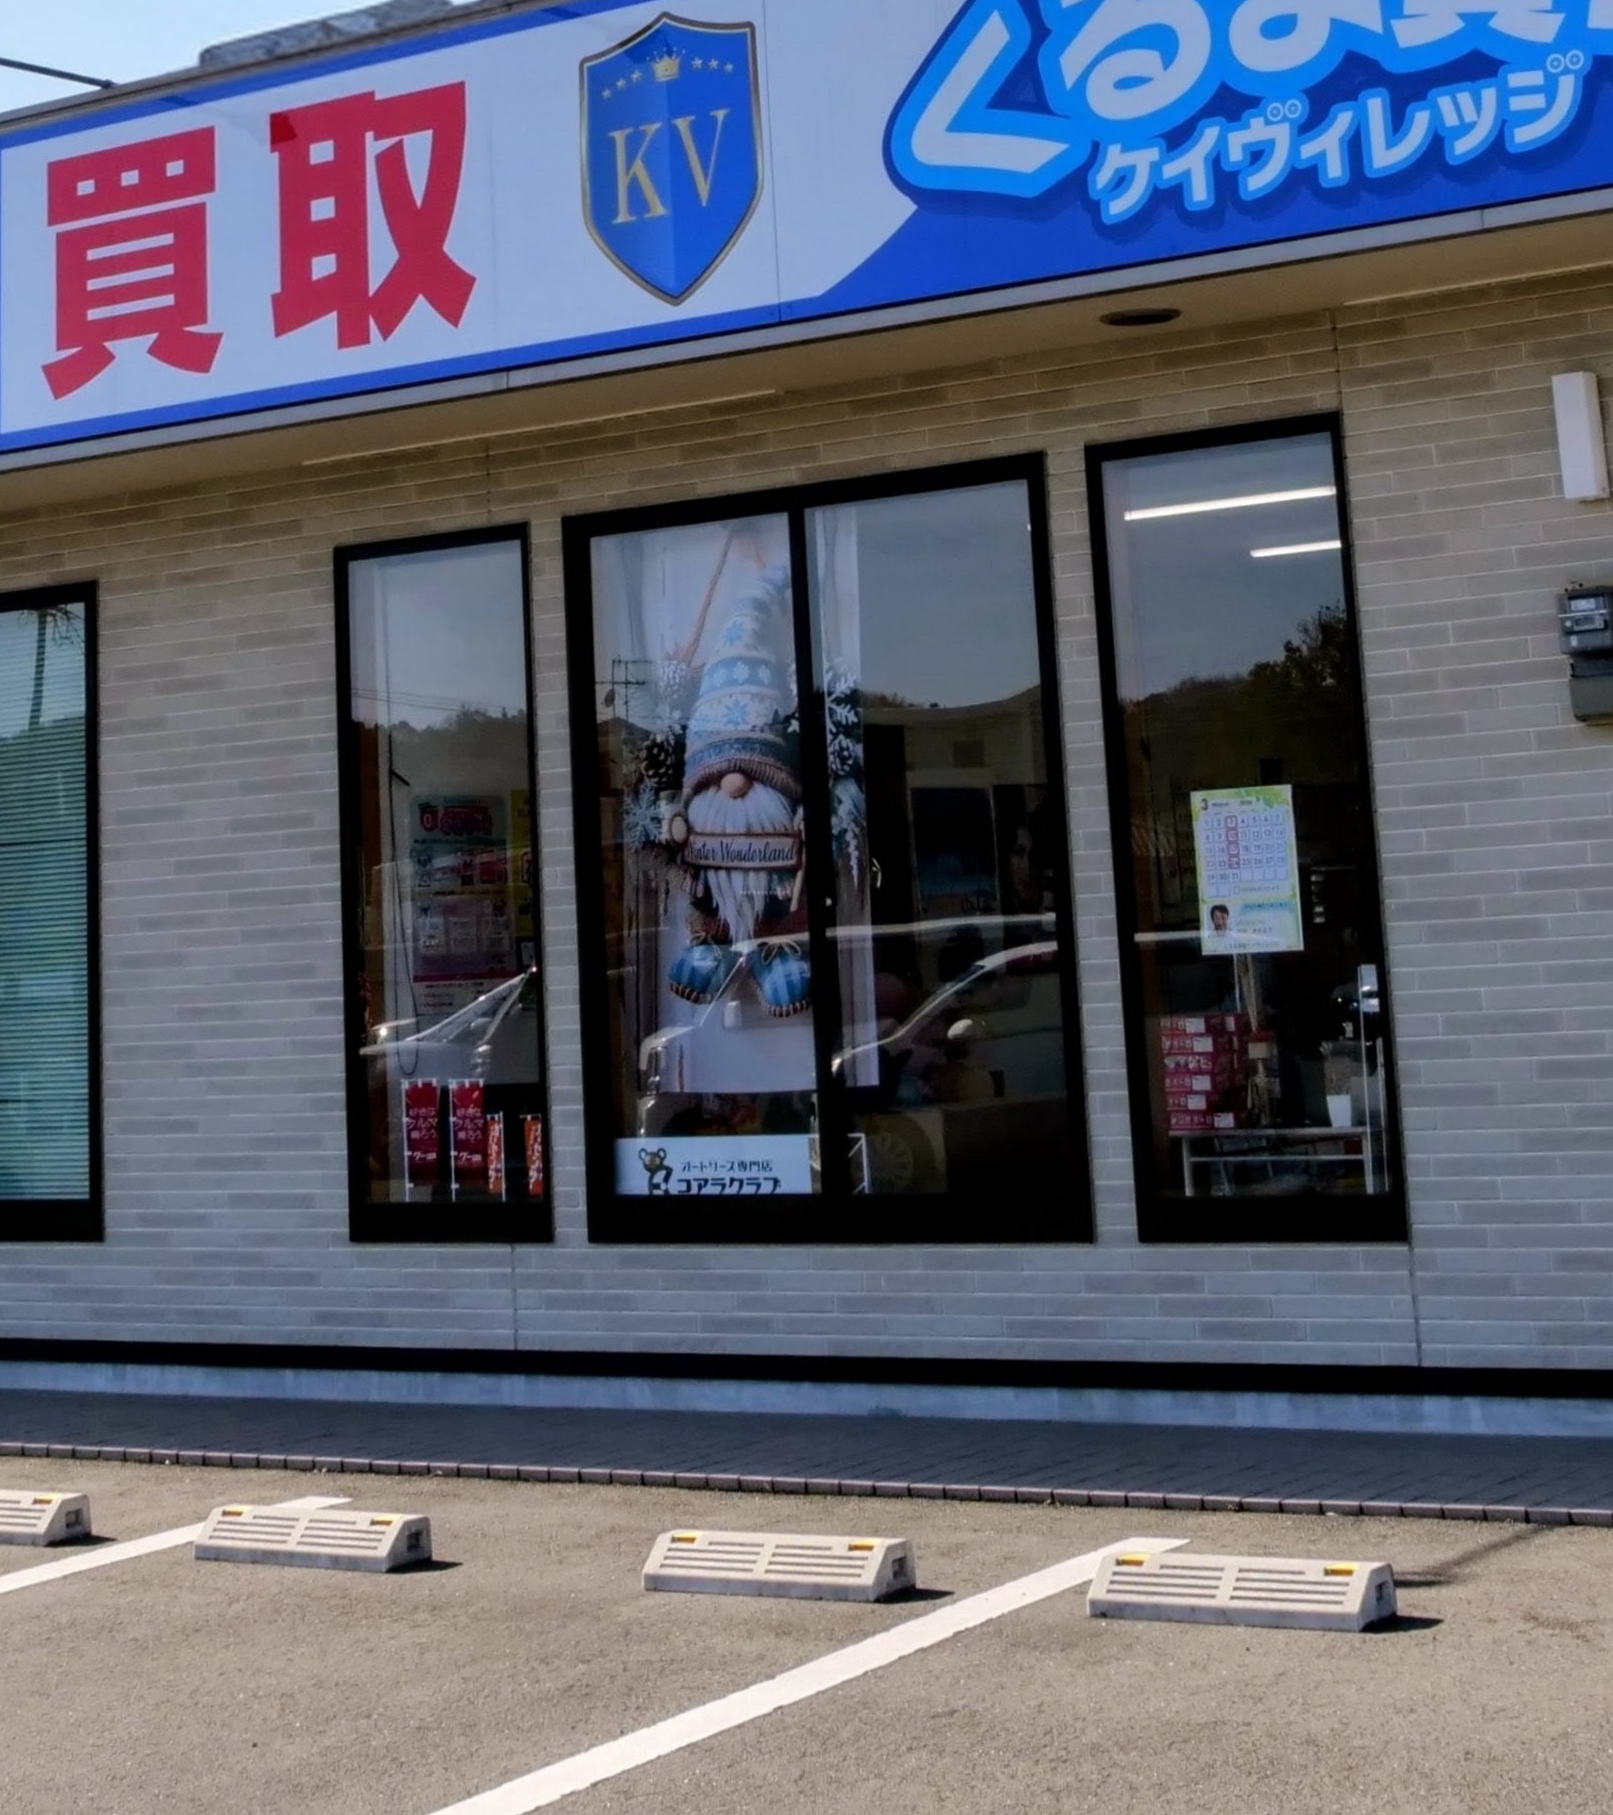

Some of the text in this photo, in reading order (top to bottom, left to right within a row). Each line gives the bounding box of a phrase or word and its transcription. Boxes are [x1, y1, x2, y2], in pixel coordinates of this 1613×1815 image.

[606, 107, 732, 225] KV
[1095, 49, 1588, 217] ケイヴィレッジ
[40, 80, 477, 401] 買取
[720, 839, 796, 863] Wonderland
[681, 1160, 773, 1173] オートリース専門店
